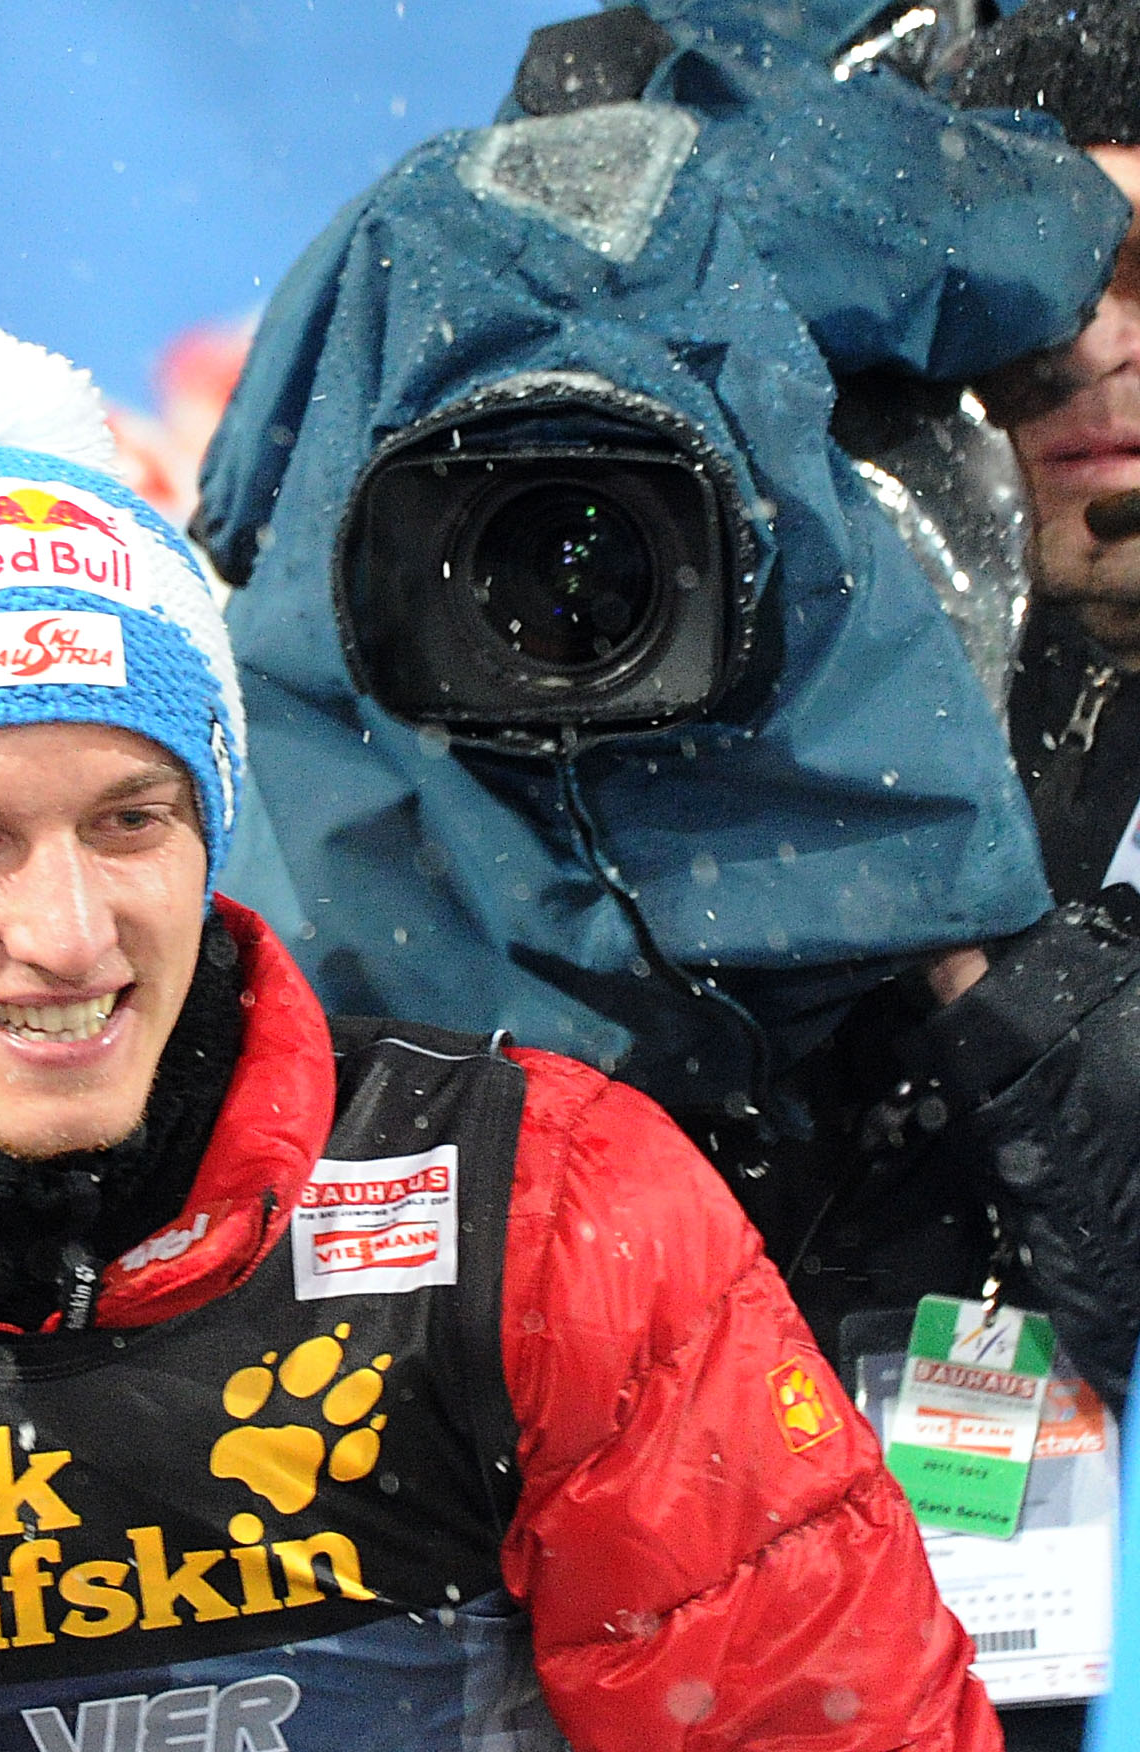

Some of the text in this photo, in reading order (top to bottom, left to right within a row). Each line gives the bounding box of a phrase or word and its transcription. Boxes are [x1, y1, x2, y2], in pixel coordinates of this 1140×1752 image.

[50, 541, 131, 591] Bull
[300, 1168, 448, 1206] BAUHAUS
[915, 1358, 1037, 1400] BAUHAUS
[20, 1673, 301, 1752] VIER
